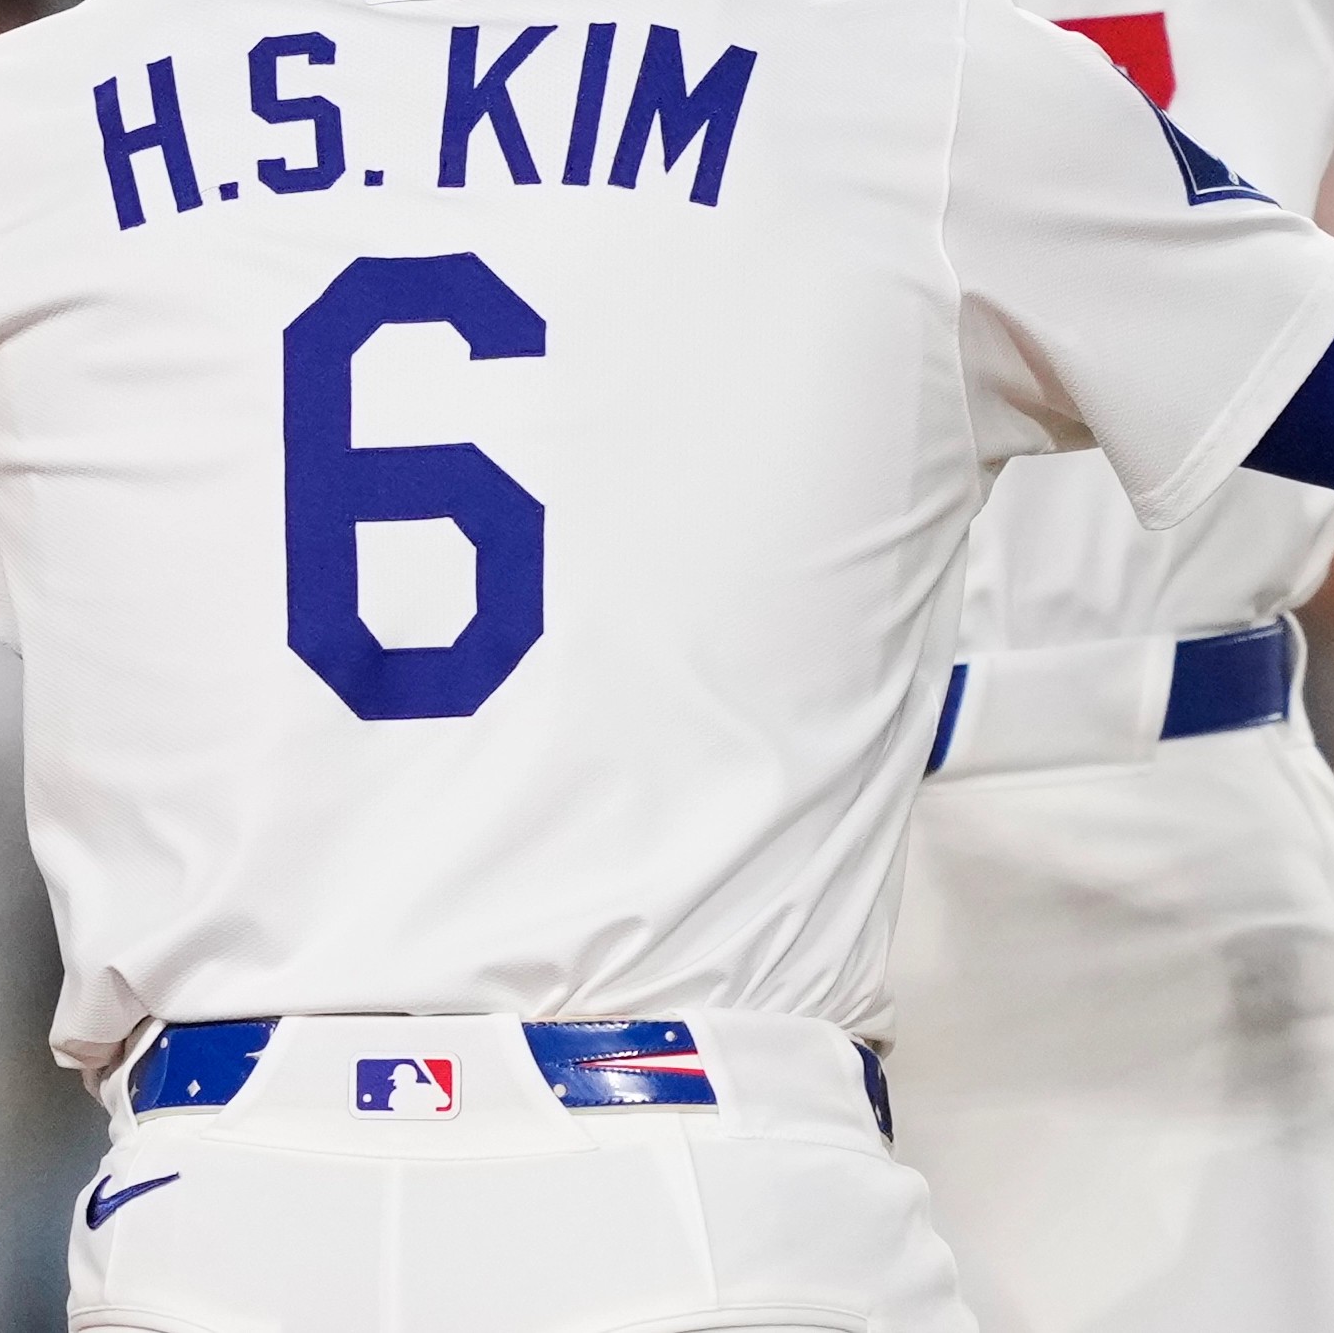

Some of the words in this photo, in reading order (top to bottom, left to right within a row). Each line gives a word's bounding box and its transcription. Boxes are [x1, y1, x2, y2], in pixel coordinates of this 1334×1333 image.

[94, 32, 384, 230] H.S.
[438, 23, 758, 207] KIM
[283, 252, 546, 720] 6
